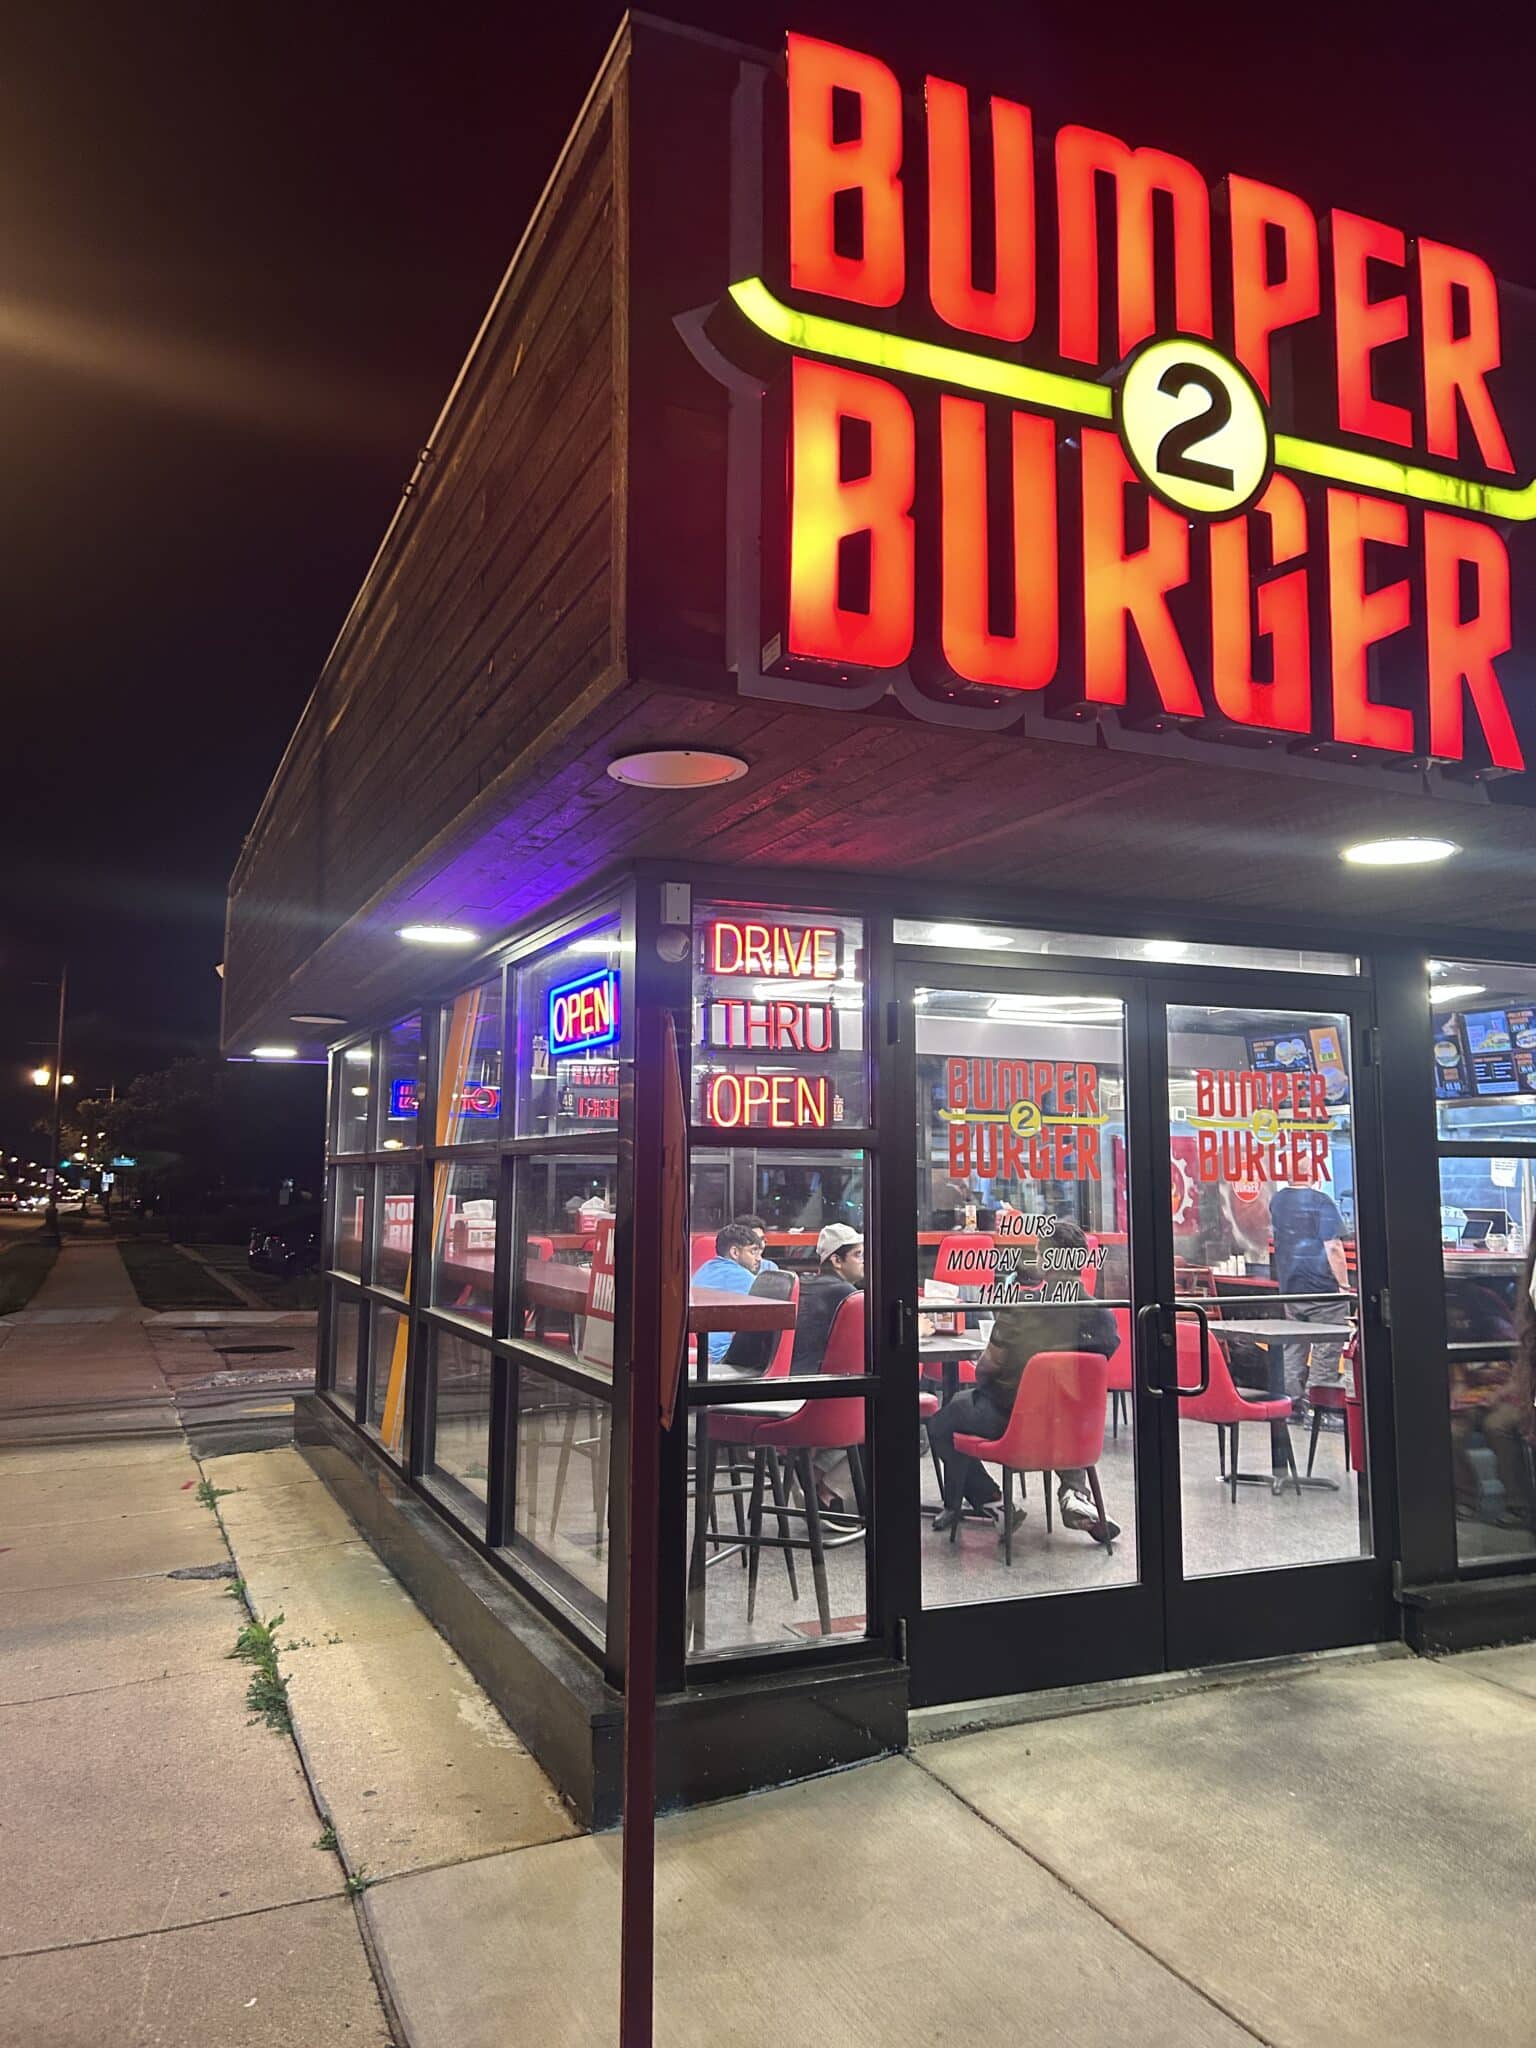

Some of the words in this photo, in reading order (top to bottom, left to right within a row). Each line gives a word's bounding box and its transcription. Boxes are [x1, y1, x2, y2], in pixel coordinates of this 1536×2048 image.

[787, 32, 1515, 474] BUMPER
[1156, 363, 1235, 491] 2
[788, 355, 1524, 771] BURGER
[714, 922, 837, 978] DRIVE
[553, 980, 610, 1042] OPEN
[717, 999, 832, 1051] THRU
[711, 1075, 826, 1128] OPEN
[946, 1058, 1098, 1113] BUMPER
[1196, 1069, 1329, 1120] BUMPER
[1017, 1106, 1034, 1130] 2
[948, 1123, 1101, 1181] BURGER
[1198, 1129, 1332, 1182] BURGER
[1000, 1215, 1056, 1236] HOURS
[947, 1248, 1022, 1271] MONDAY
[1043, 1248, 1108, 1271] SUNDAY
[979, 1284, 1019, 1304] 11AM
